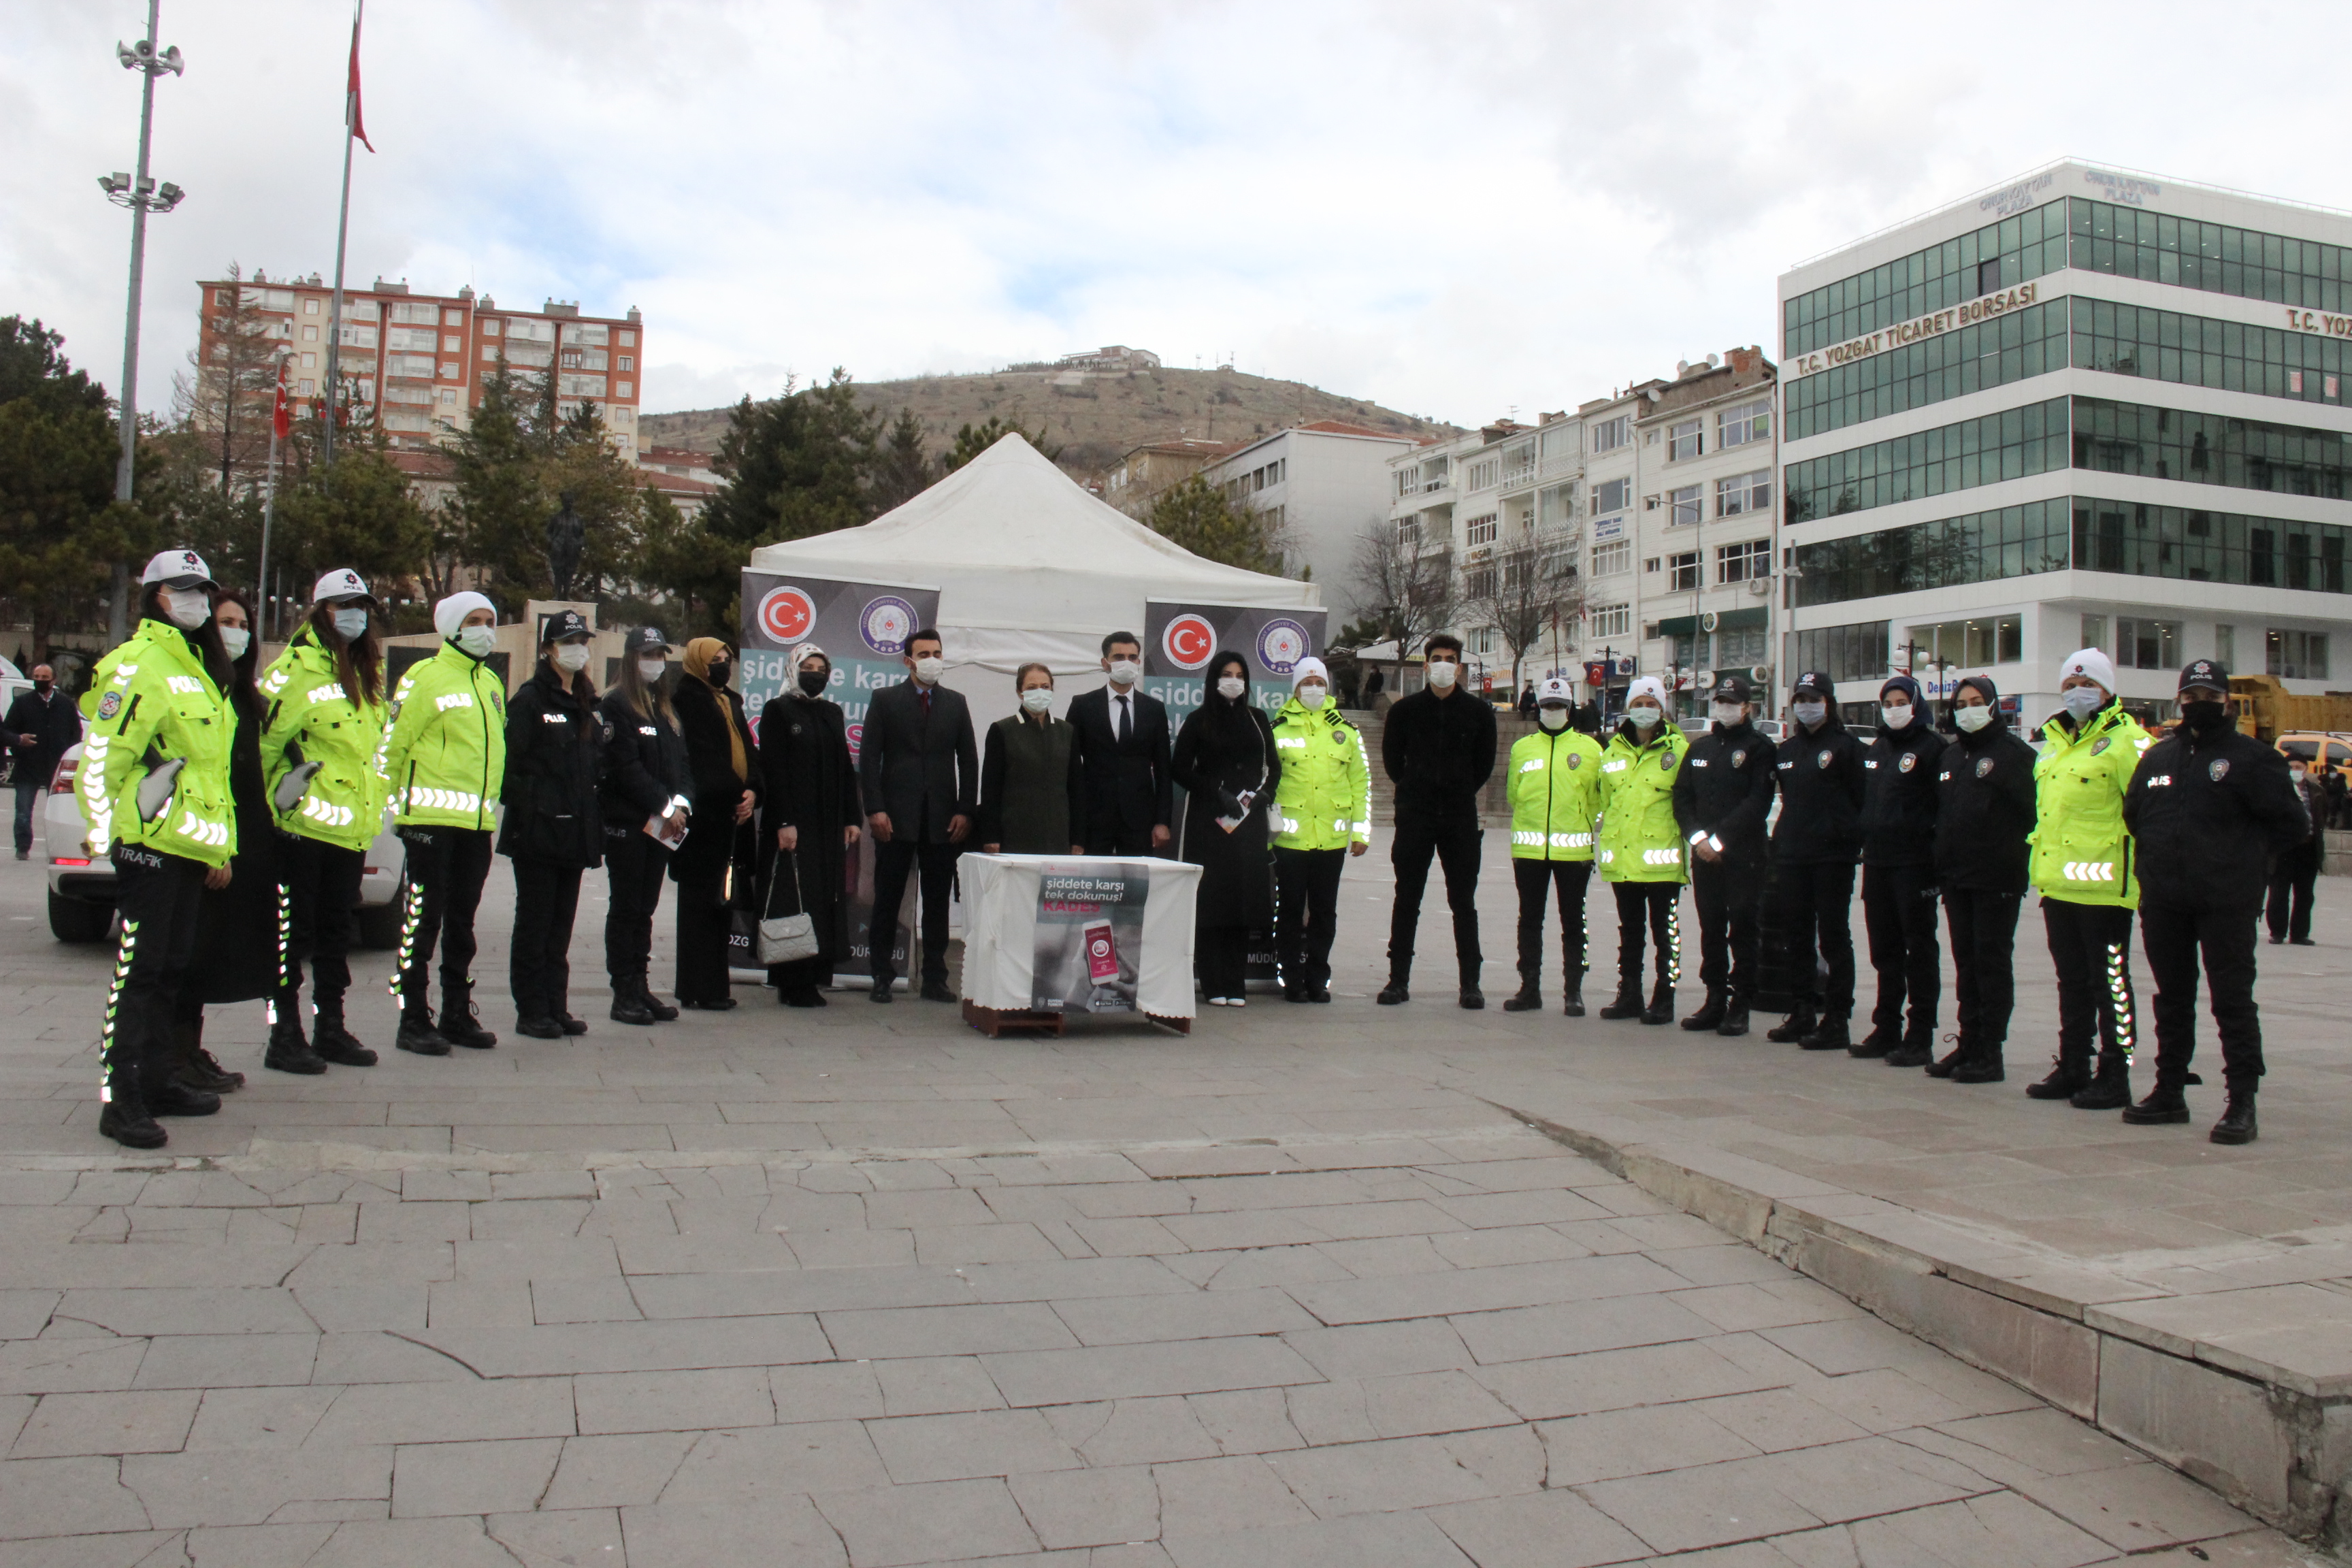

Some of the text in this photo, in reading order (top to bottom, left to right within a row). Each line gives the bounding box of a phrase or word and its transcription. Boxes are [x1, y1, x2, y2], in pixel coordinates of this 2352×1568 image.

[2287, 309, 2319, 332] T.C.
[1797, 283, 2038, 375] T.C. YOZGAT TİCARET BORSASI
[1047, 878, 1124, 892] şiddete karşı
[1045, 890, 1123, 902] tek dokunuş!
[1043, 900, 1100, 912] KADES
